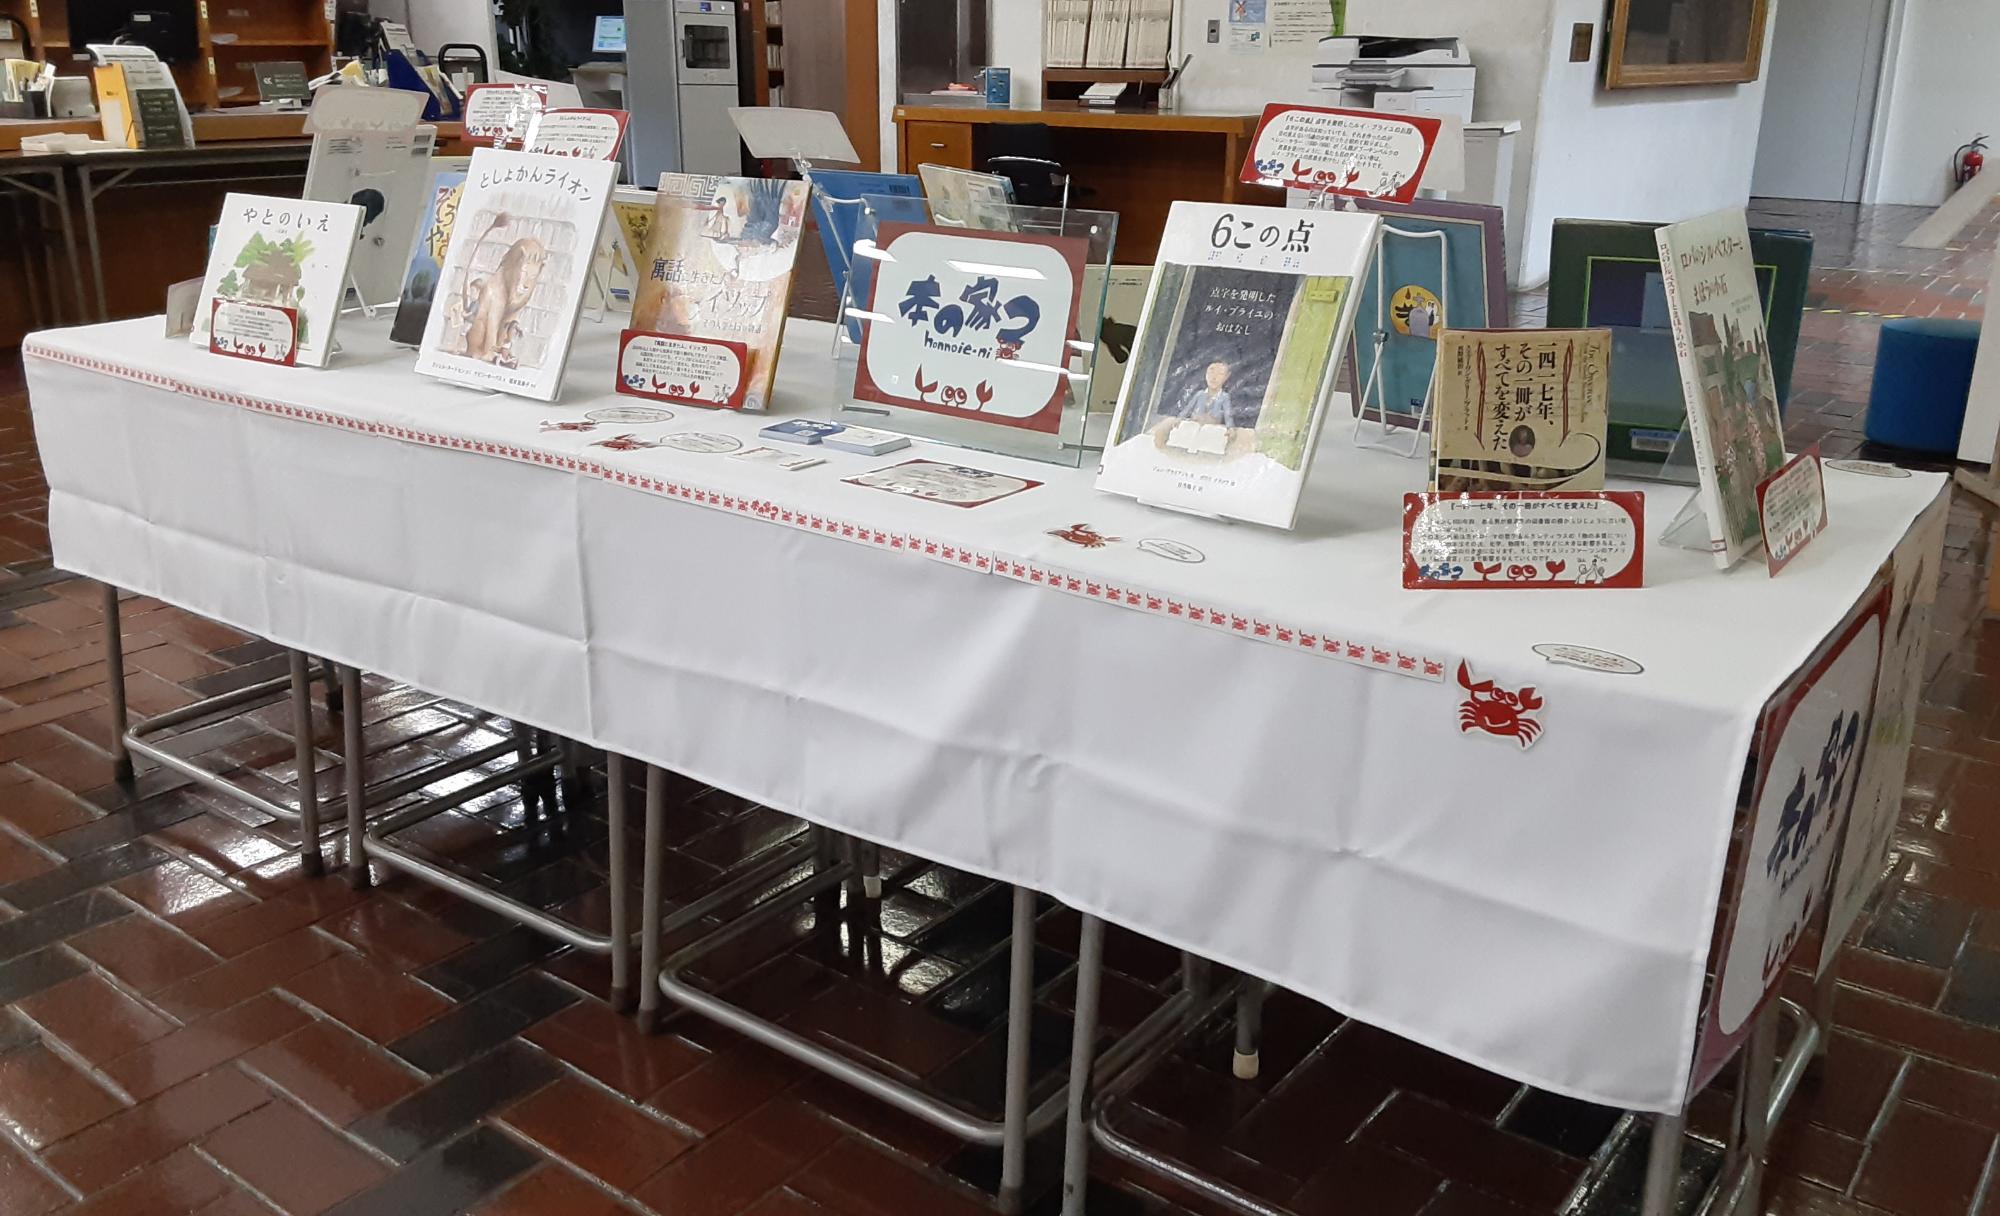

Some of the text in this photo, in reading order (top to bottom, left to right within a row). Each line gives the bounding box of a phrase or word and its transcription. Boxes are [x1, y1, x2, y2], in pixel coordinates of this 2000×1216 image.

[479, 165, 592, 202] としょかんライオン
[243, 207, 328, 232] やとのいえ
[1211, 213, 1314, 253] 6この点
[1209, 286, 1276, 304] 点字を発明した
[1204, 304, 1275, 321] ルイ・ブライユの
[1216, 321, 1251, 336] おはなし
[1493, 343, 1511, 451] すべてを変えた
[1514, 342, 1534, 422] その一冊が
